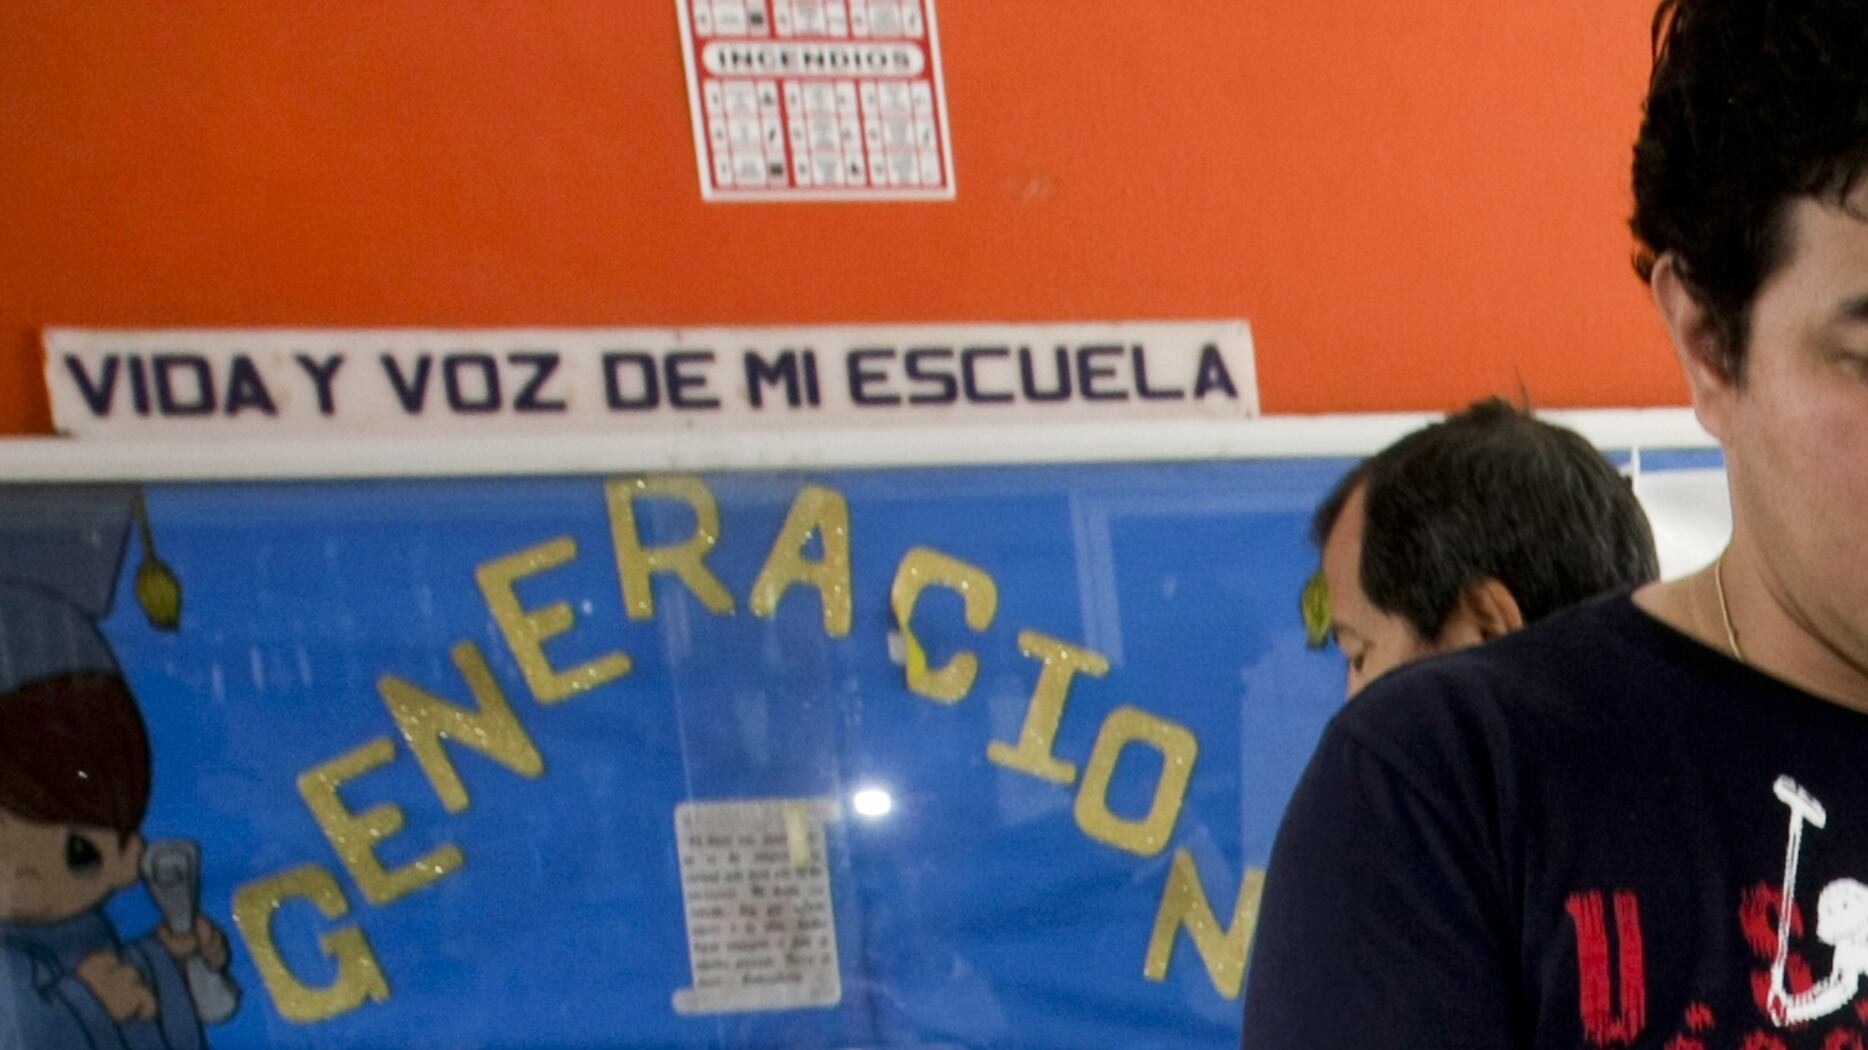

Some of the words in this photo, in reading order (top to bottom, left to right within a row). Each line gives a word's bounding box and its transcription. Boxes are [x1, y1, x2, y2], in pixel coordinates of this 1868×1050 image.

[63, 352, 279, 418] VIDA
[295, 352, 346, 416] Y
[381, 351, 569, 415] VOZ
[601, 349, 721, 411] DE
[743, 347, 822, 409] MI
[845, 342, 1240, 405] ESCUELA
